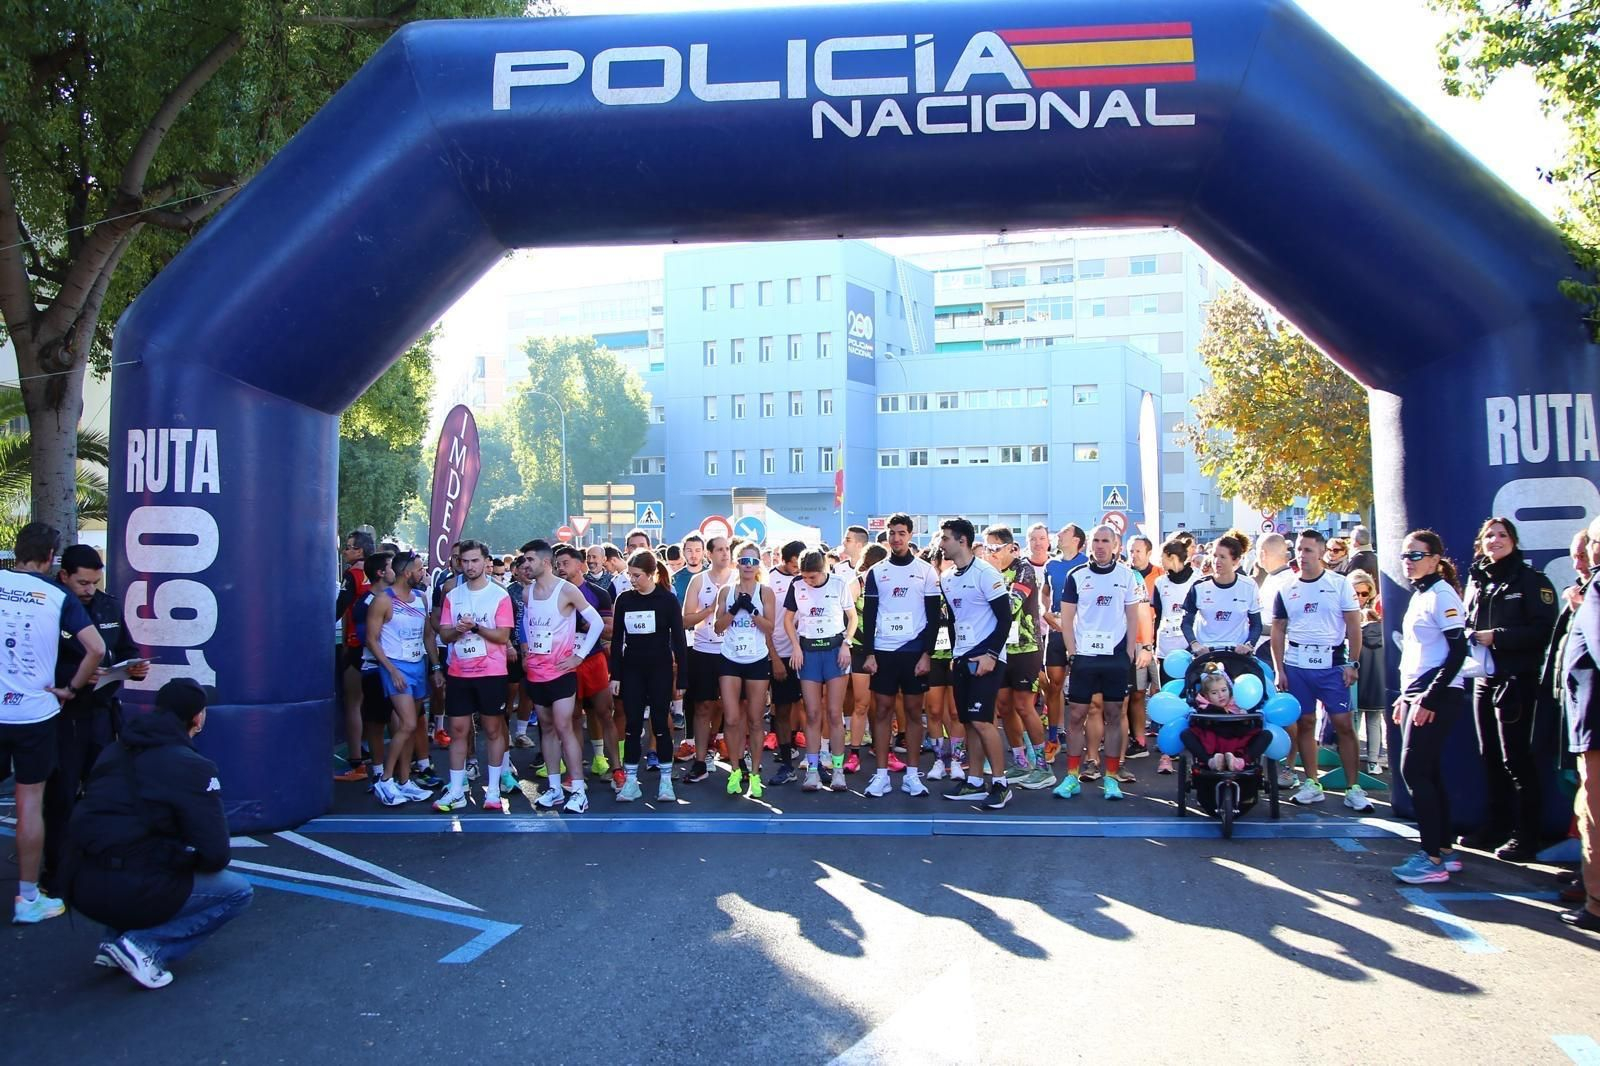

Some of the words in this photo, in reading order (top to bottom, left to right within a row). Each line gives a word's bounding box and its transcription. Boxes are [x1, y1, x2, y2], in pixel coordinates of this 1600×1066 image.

[812, 88, 1196, 139] NACIONAL
[1486, 394, 1600, 466] RUTA
[126, 428, 220, 494] RUTA
[731, 618, 757, 628] ndea
[463, 646, 476, 654] 840
